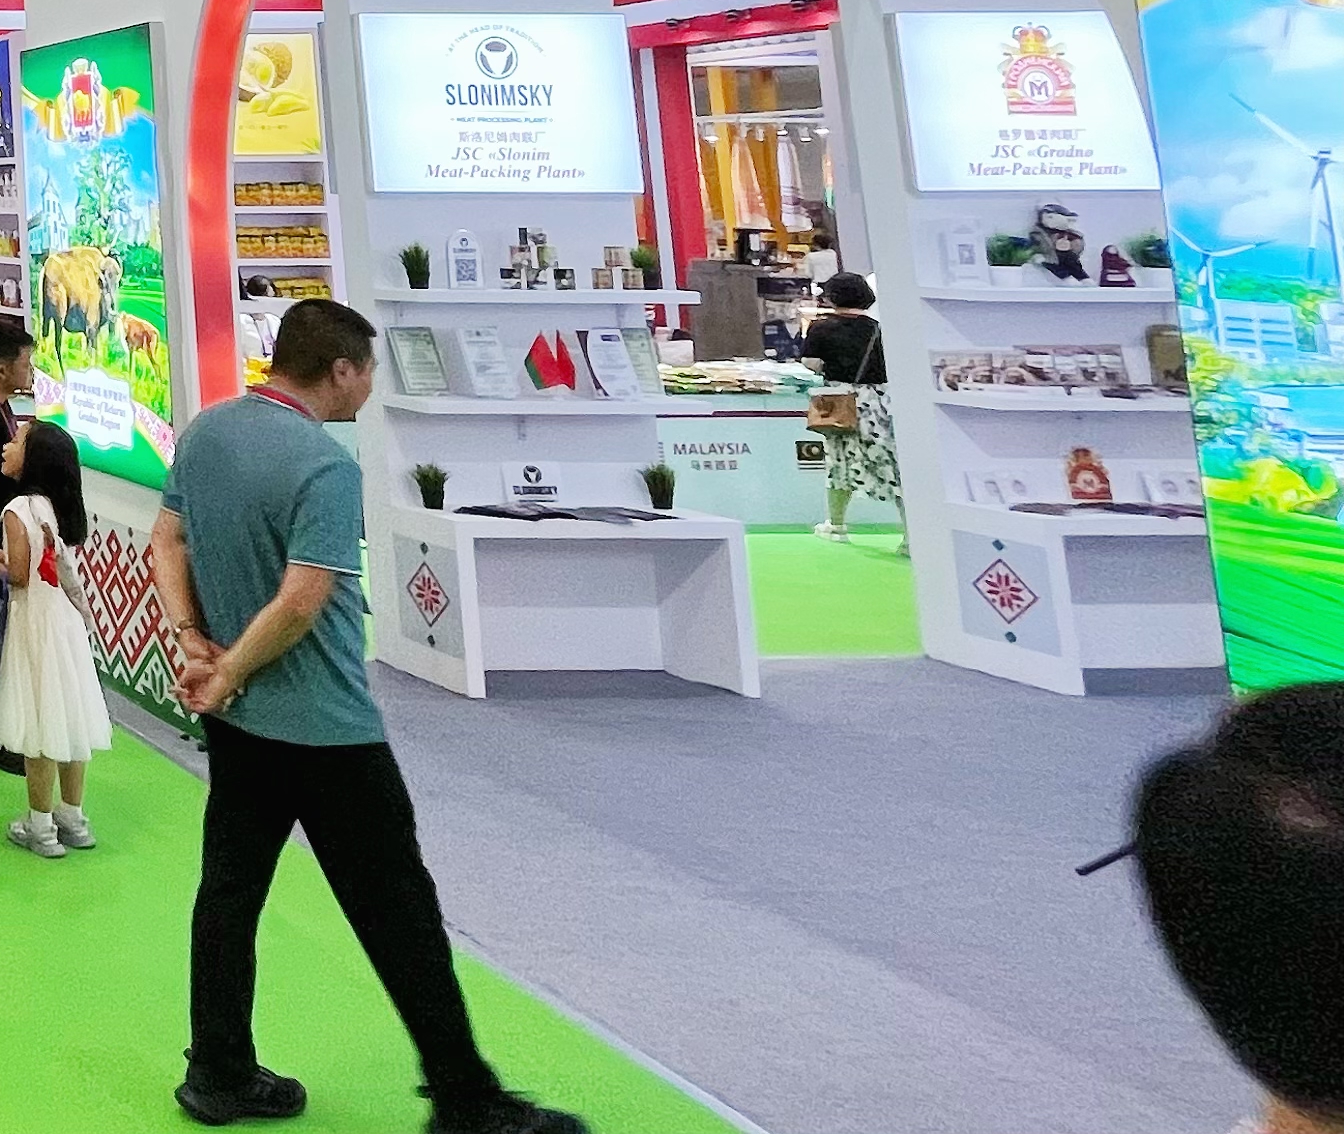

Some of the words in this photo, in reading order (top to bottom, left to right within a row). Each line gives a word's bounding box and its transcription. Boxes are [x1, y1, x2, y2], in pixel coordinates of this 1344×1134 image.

[445, 83, 554, 107] SLONIMSKY
[451, 146, 484, 161] JSC
[991, 144, 1024, 158] JSC
[425, 164, 531, 182] Meat-Packing
[968, 161, 1073, 179] Meat-Packing
[673, 442, 752, 455] MALAYSIA
